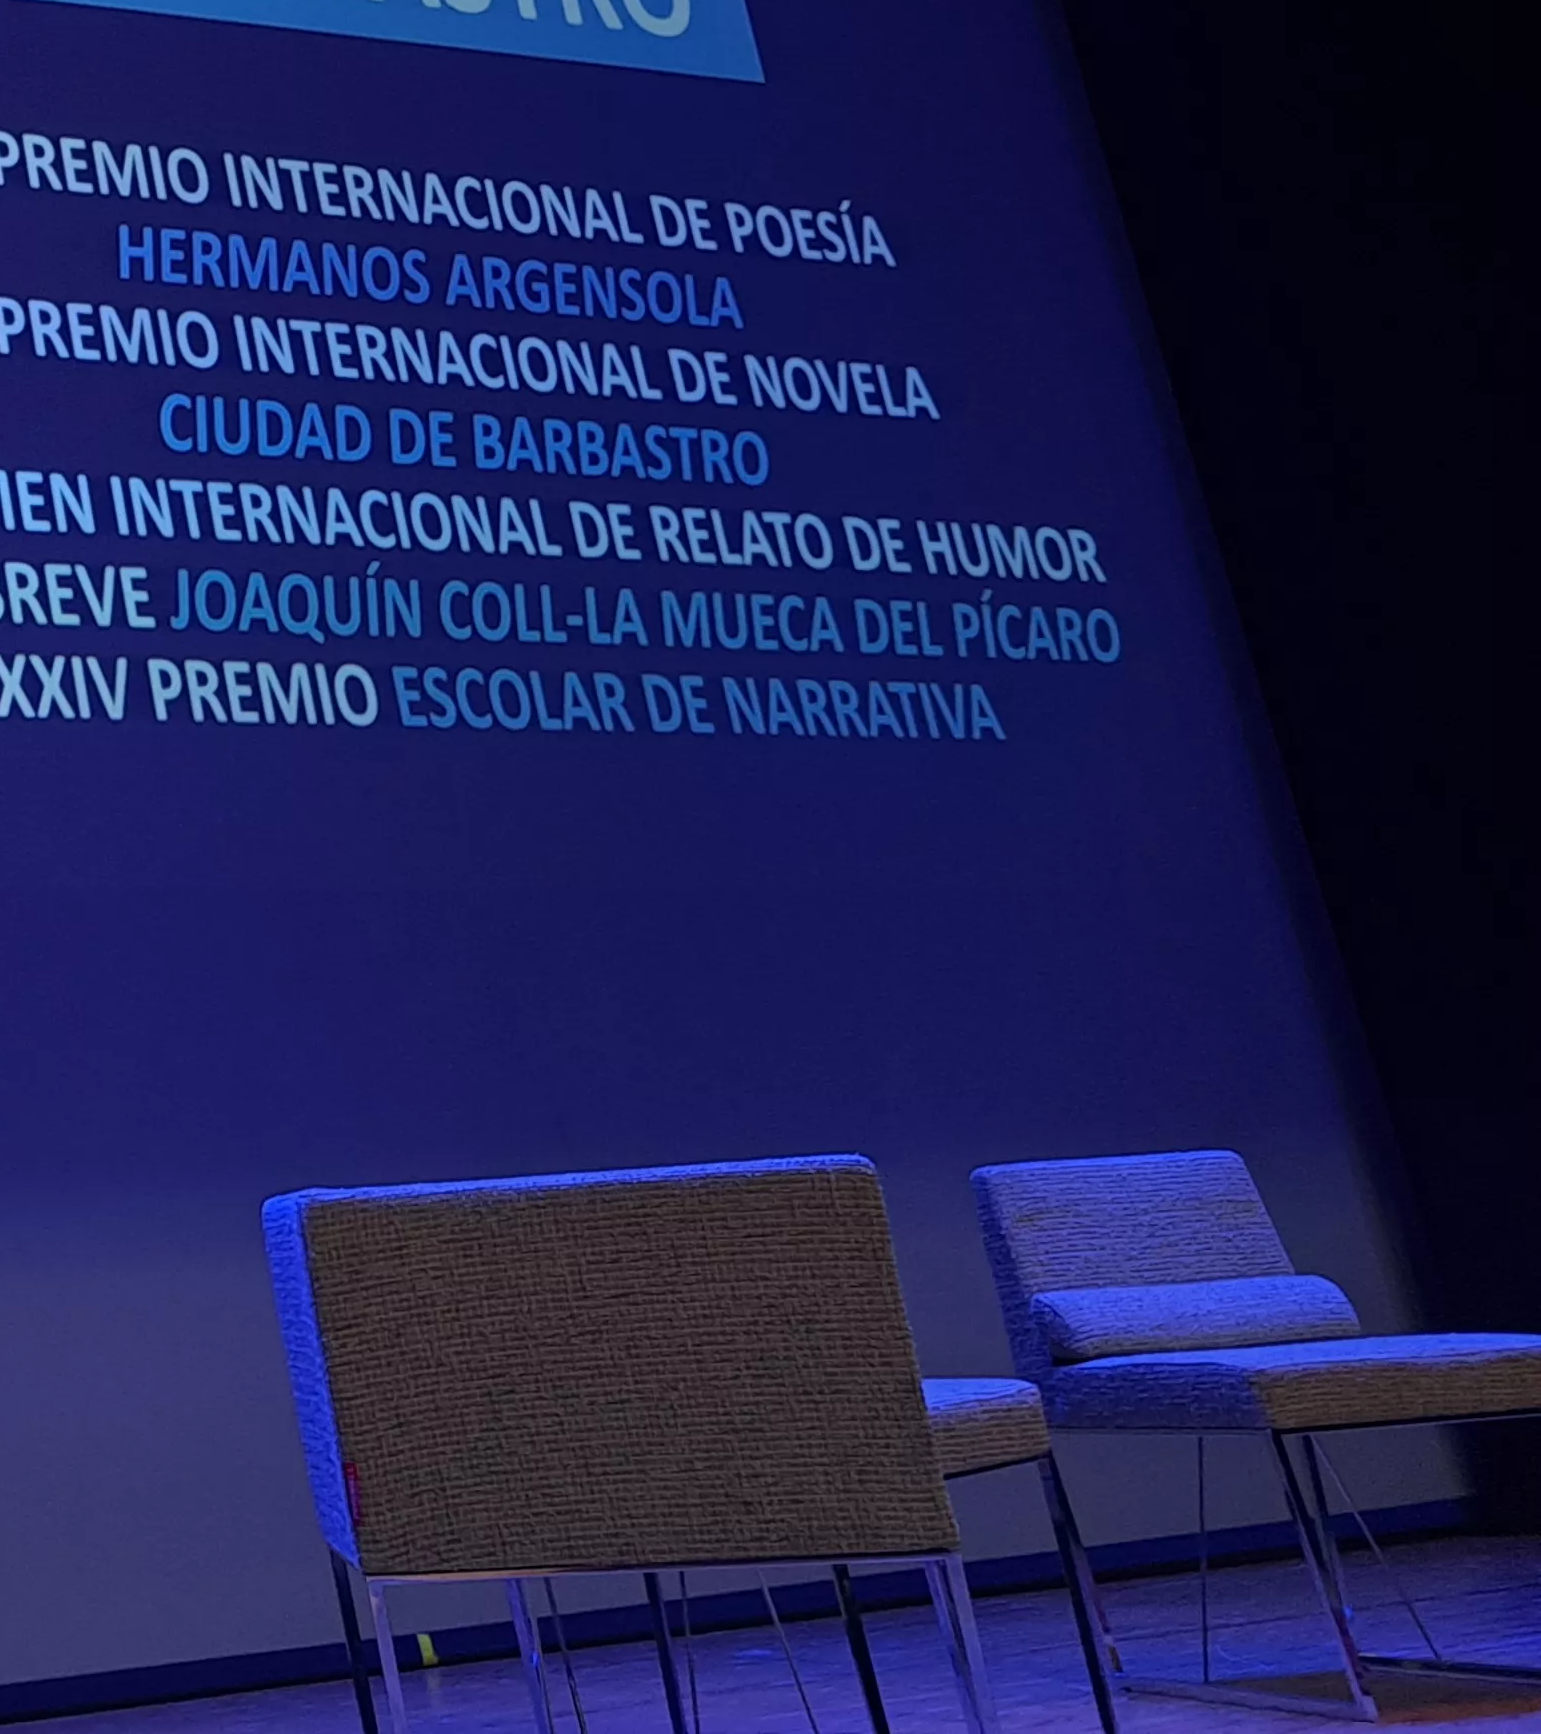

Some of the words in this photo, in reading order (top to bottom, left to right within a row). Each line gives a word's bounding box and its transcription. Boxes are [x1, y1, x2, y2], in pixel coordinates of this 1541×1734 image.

[223, 153, 644, 244] INTERNACIONAL
[649, 195, 718, 250] DE
[724, 200, 896, 267] POESÍA
[119, 224, 430, 304] HERMANOS
[446, 254, 744, 329] ARGENSOLA
[233, 314, 663, 400] INTERNACIONAL
[667, 348, 738, 405] DE
[744, 354, 941, 420] NOVELA
[160, 393, 371, 461] CIUDAD
[389, 408, 457, 467] DE
[473, 414, 769, 486] BARBASTRO
[110, 475, 563, 556] INTERNACIONAL
[569, 501, 642, 560] DE
[649, 505, 833, 570] RELATO
[842, 516, 912, 573] DE
[916, 520, 1107, 582] HUMOR
[170, 561, 421, 644] JOAQUÍN
[440, 580, 648, 646] COLL-LA
[661, 590, 844, 652] MUECA
[854, 599, 944, 656] DEL
[952, 589, 1120, 662] PÍCARO
[147, 658, 378, 726] PREMIO
[392, 666, 635, 732] ESCOLAR
[642, 674, 715, 733] DE
[722, 677, 1006, 740] NARRATIVA
